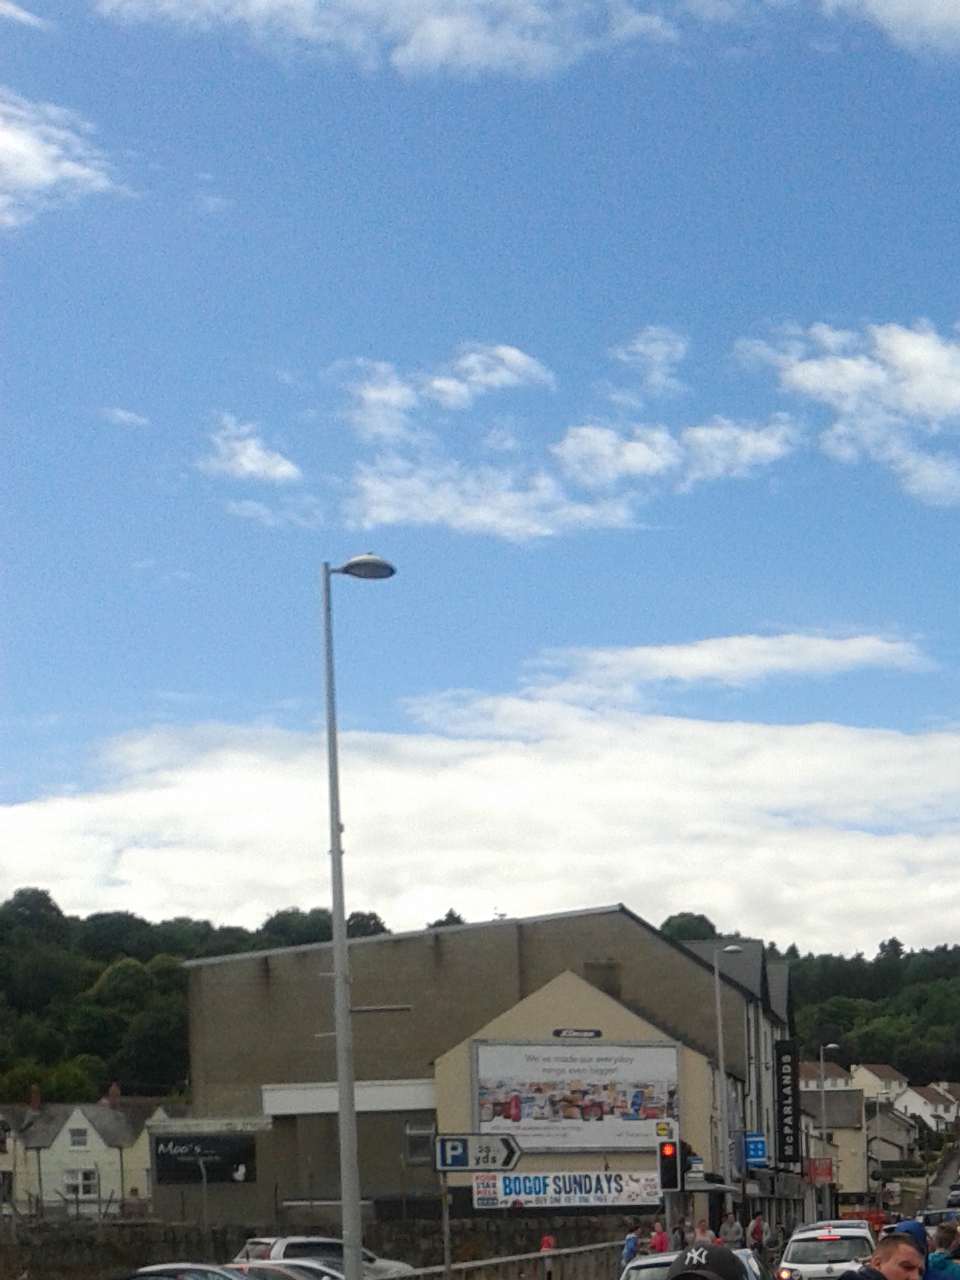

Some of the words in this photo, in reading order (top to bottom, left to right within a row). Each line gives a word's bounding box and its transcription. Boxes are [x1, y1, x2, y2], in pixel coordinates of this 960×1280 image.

[446, 1140, 463, 1165] P
[474, 1152, 497, 1166] yds
[502, 1175, 550, 1196] BOGOF
[552, 1173, 624, 1196] SUNDAYS
[684, 1246, 709, 1266] NY
